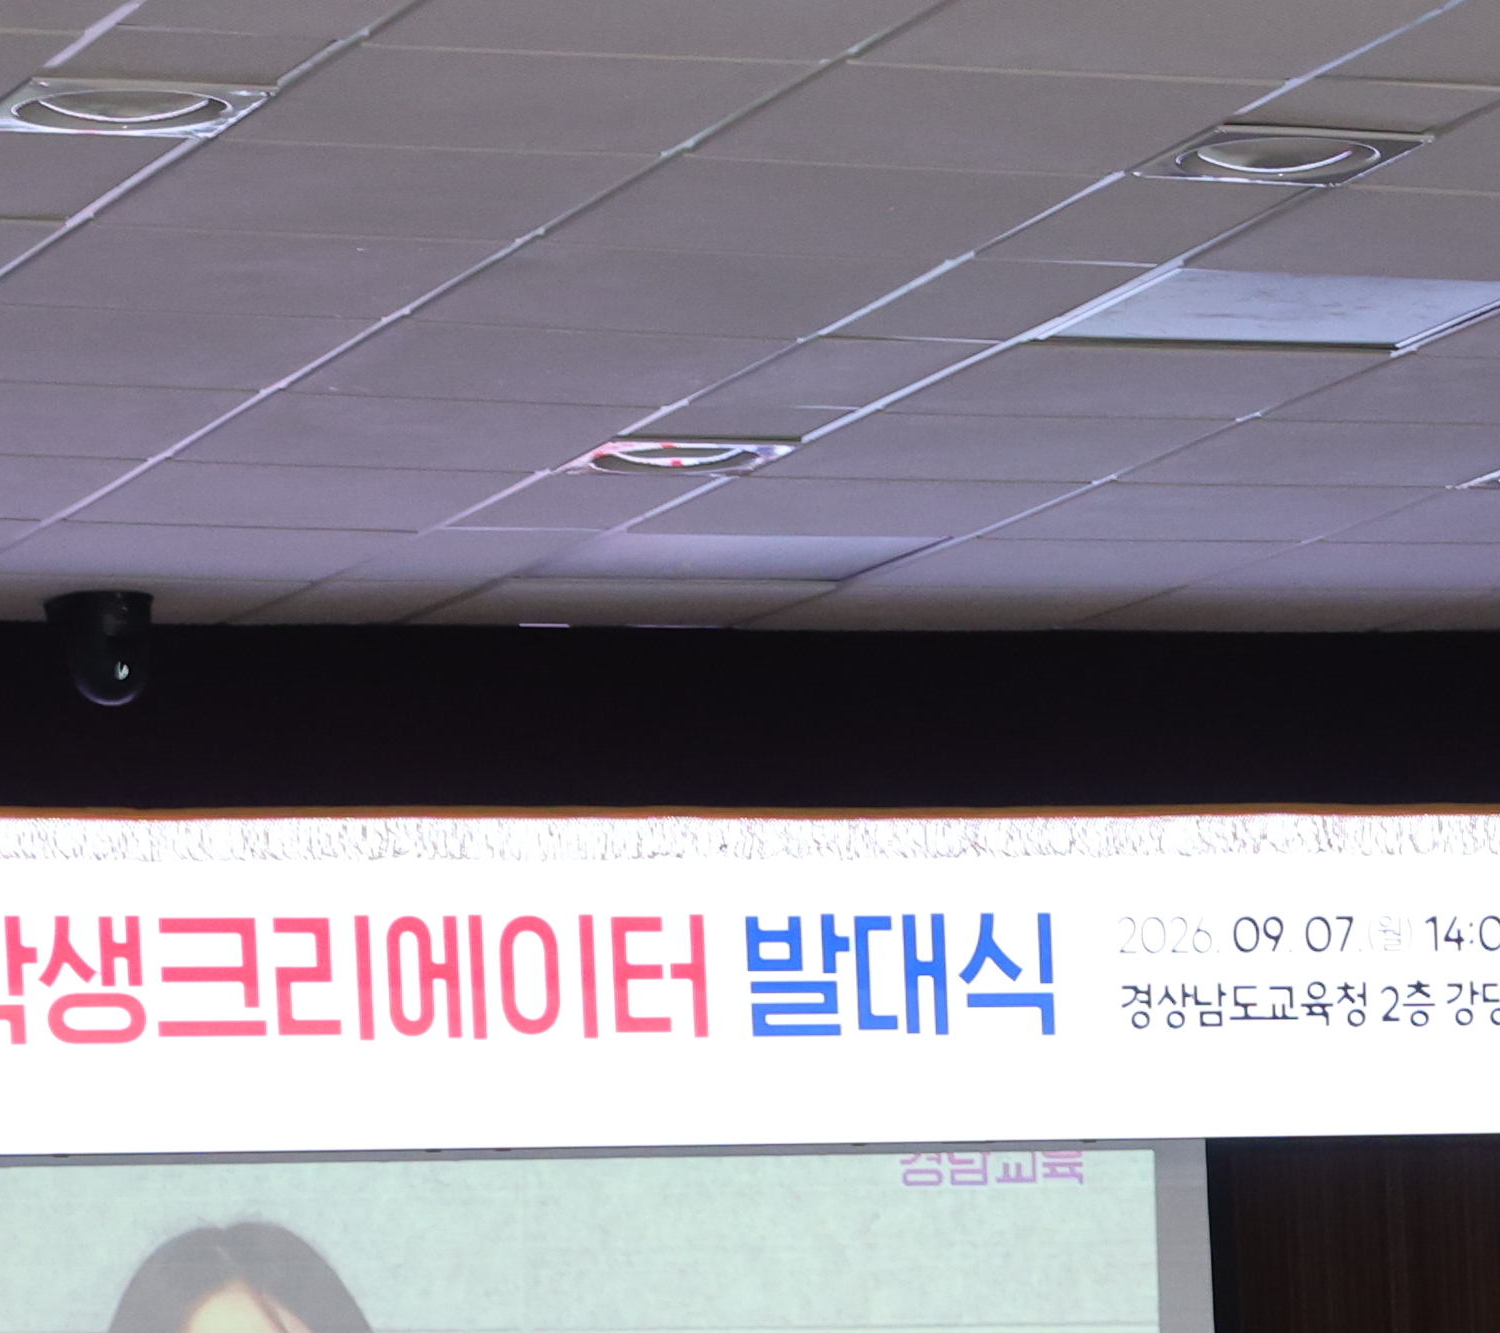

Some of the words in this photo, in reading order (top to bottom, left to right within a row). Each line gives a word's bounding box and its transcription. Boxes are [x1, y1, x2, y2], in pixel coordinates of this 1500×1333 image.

[1118, 915, 1220, 954] 2026.
[745, 911, 1059, 1038] 발대식
[1121, 981, 1368, 1029] 경상남도교육청
[1381, 981, 1435, 1028] 2층
